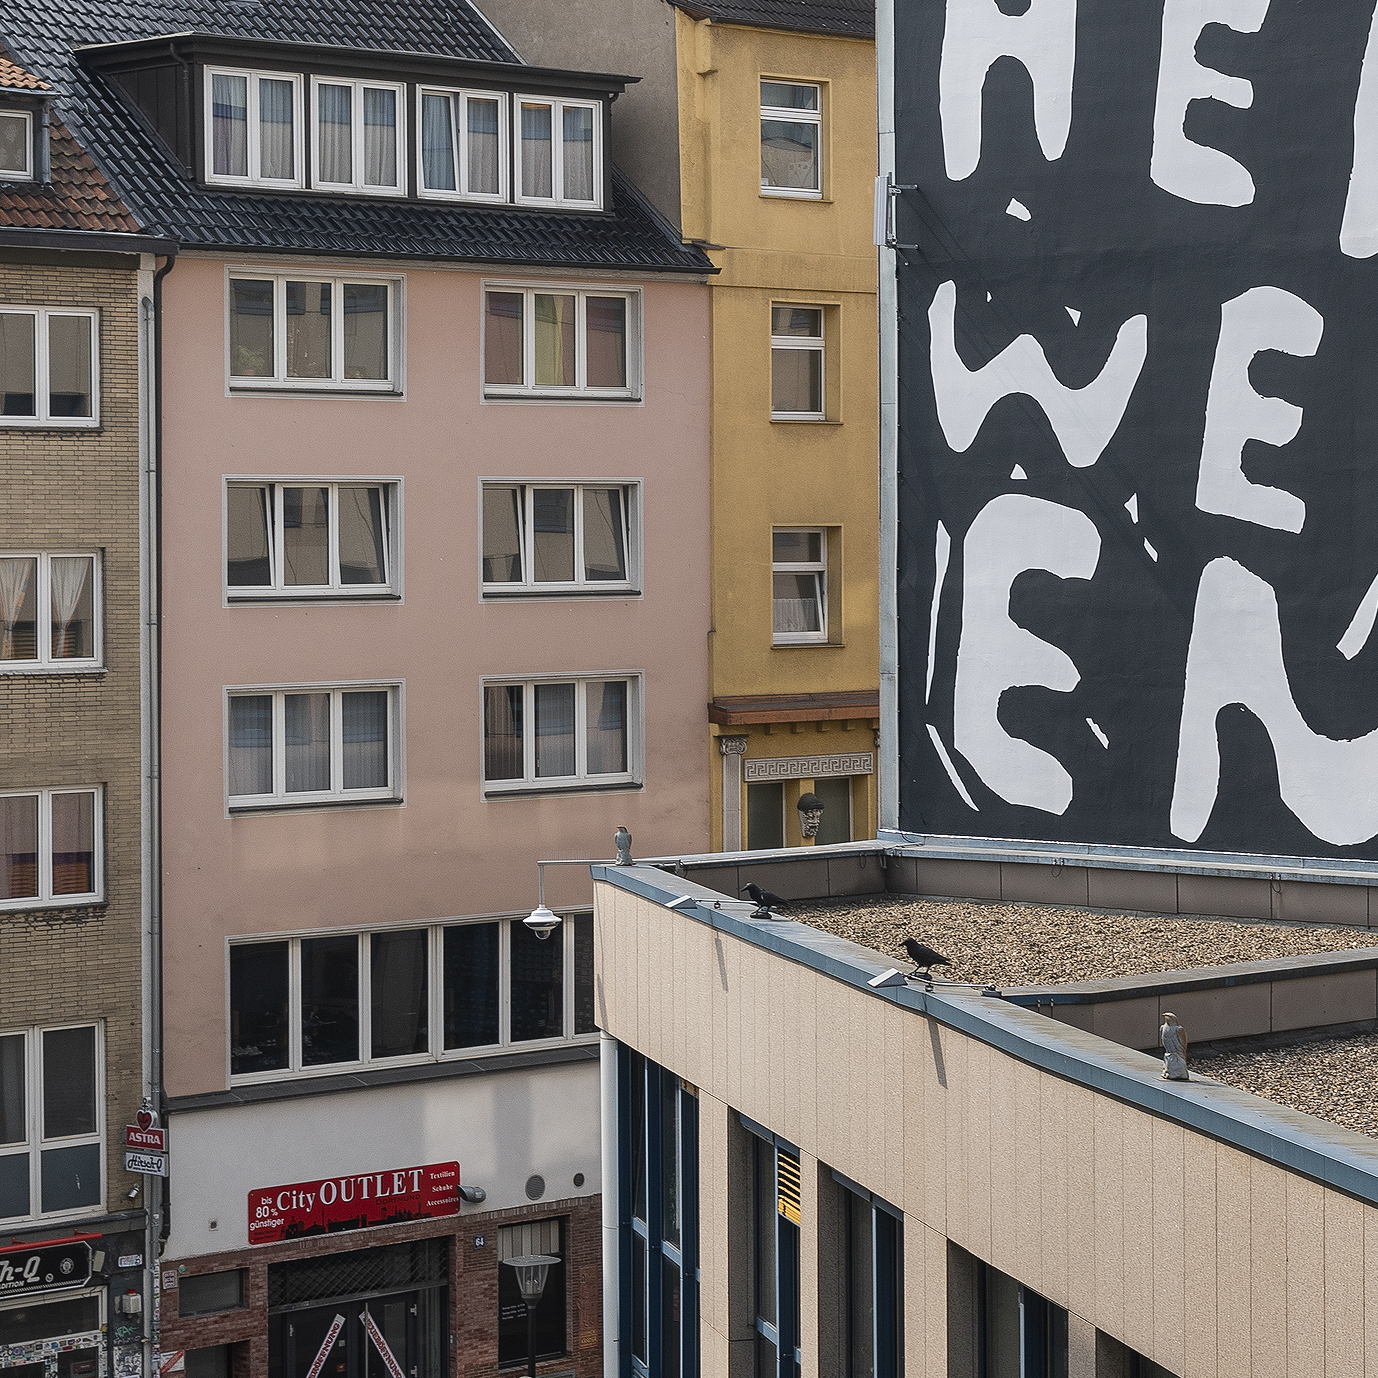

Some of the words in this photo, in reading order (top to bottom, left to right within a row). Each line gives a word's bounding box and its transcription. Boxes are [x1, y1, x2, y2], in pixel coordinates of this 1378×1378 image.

[129, 1132, 161, 1145] ASTRA
[276, 1190, 316, 1213] City
[319, 1169, 424, 1205] OUTLET
[432, 1184, 453, 1192] Schuhe
[261, 1197, 273, 1205] bis
[426, 1197, 459, 1206] Accessoires
[255, 1206, 269, 1218] 80
[249, 1218, 285, 1231] günstiger
